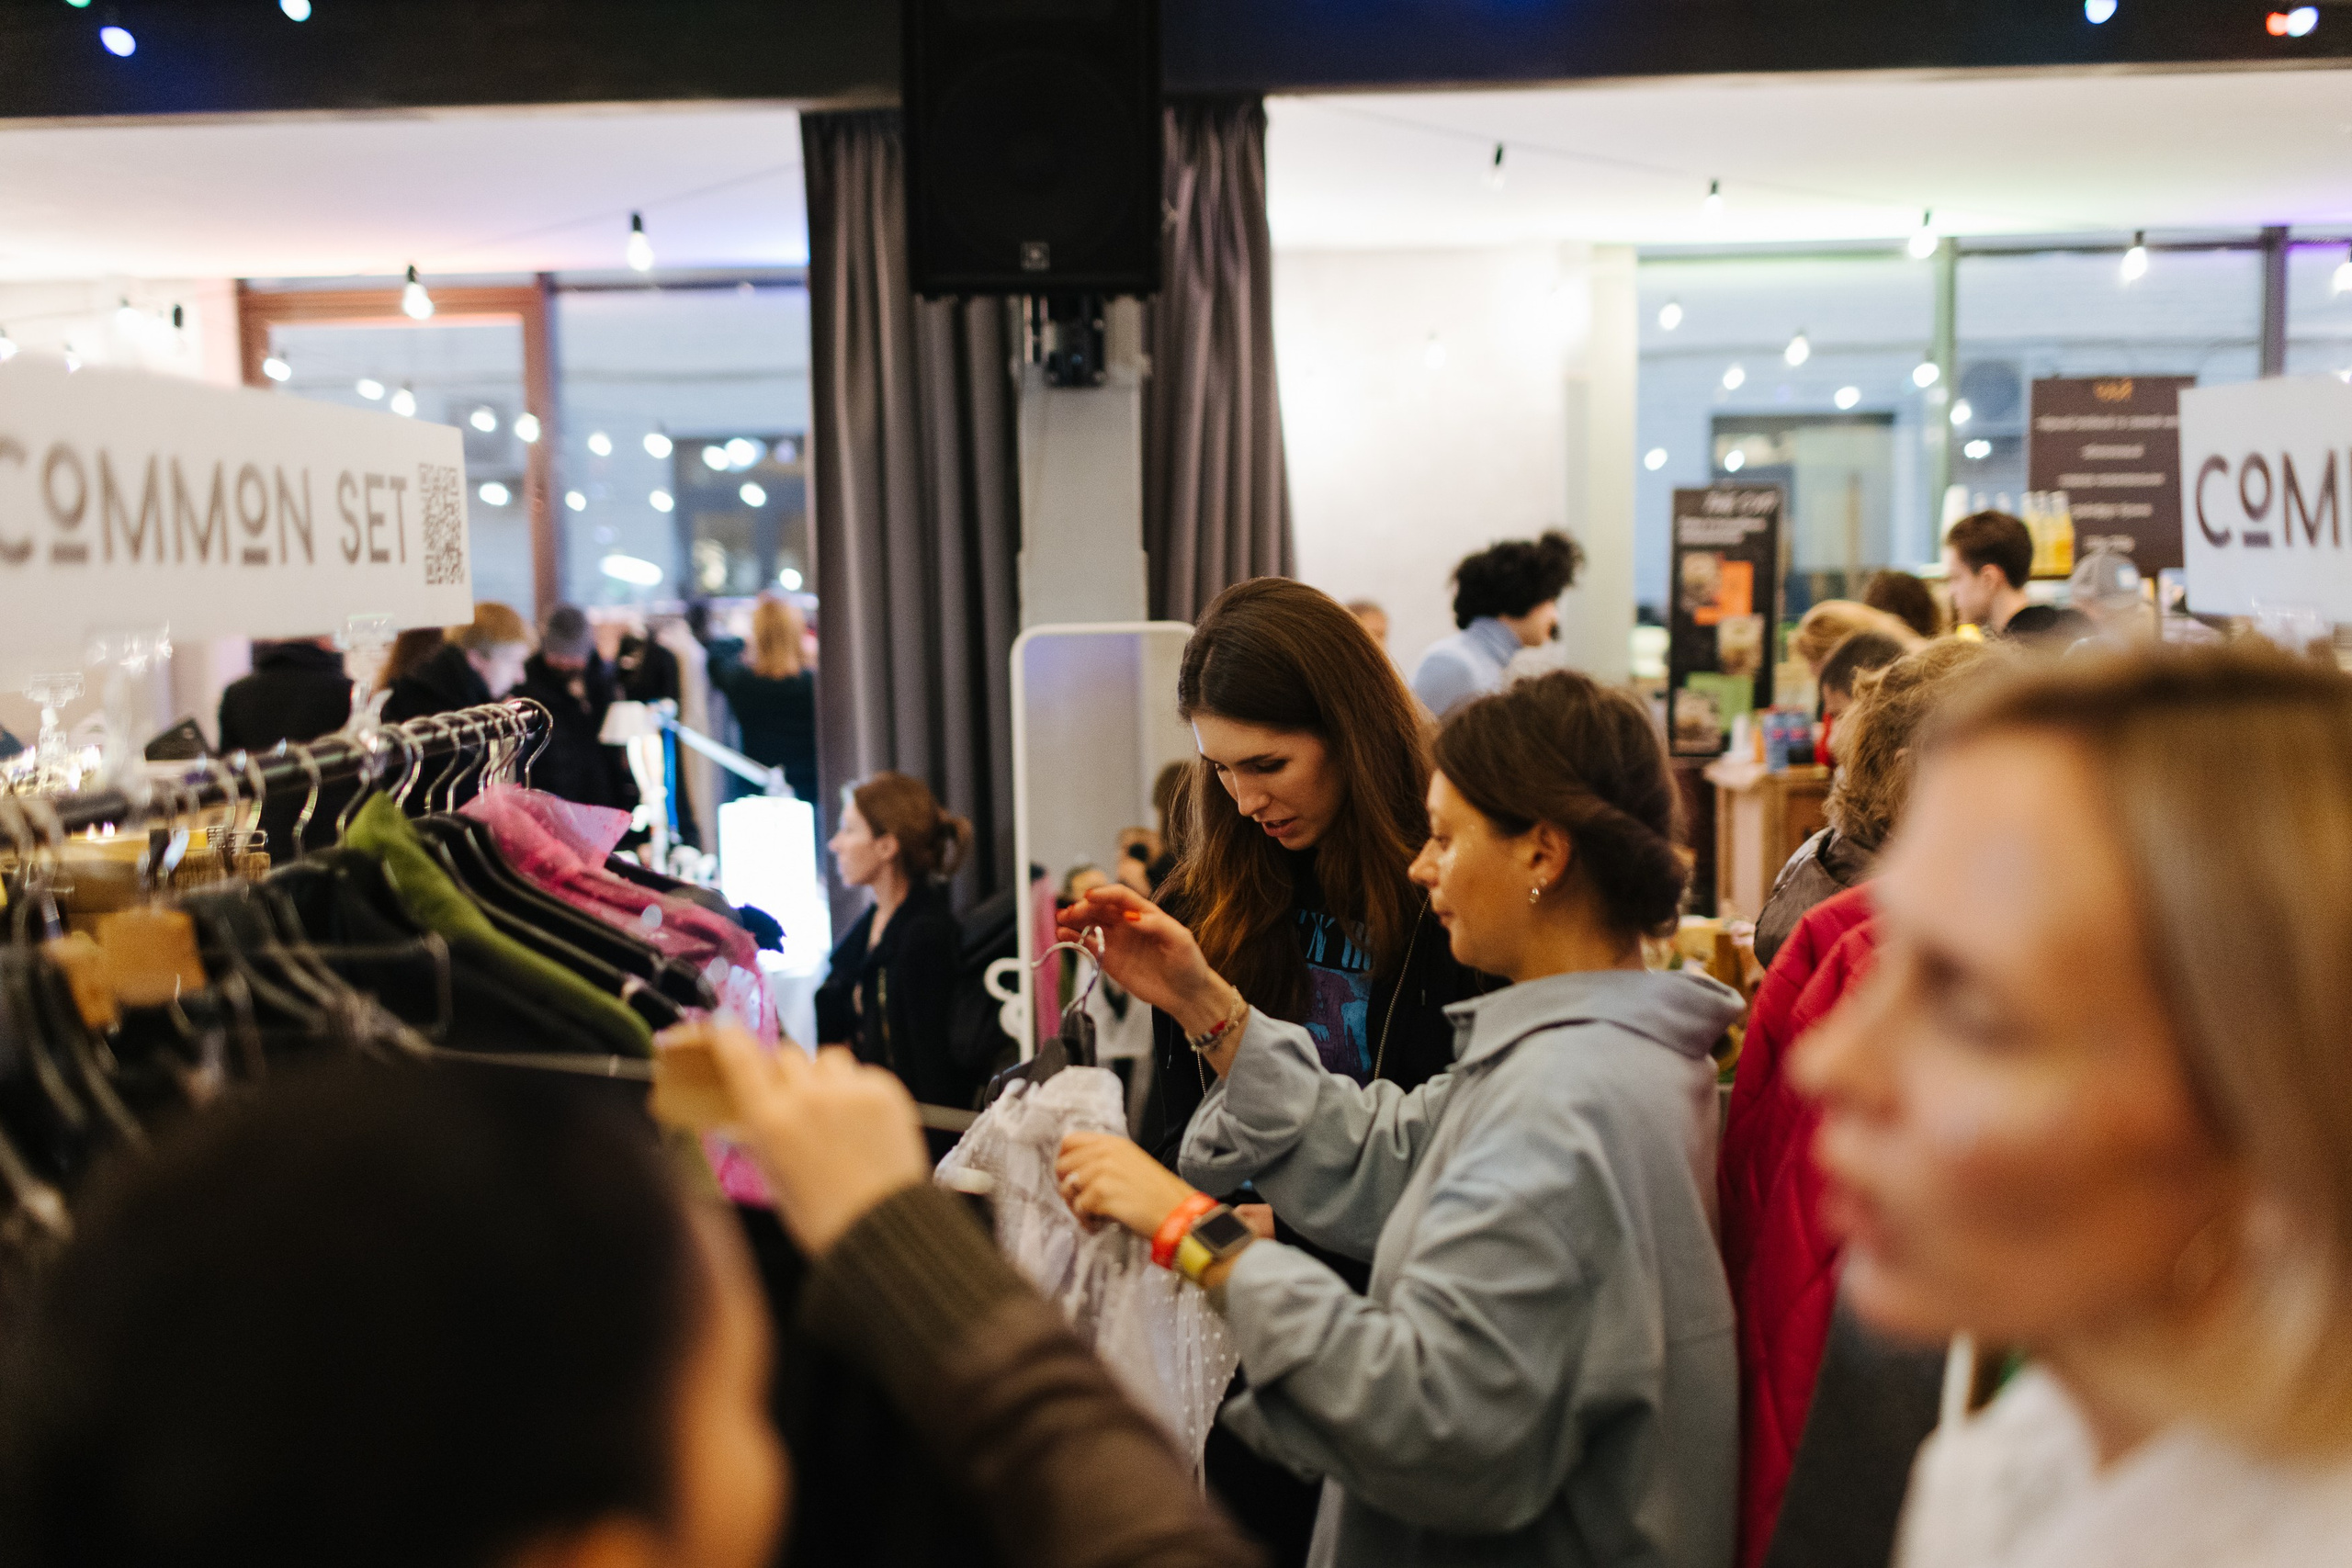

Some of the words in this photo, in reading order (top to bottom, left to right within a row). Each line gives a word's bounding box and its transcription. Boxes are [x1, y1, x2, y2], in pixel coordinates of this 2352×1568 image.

[0, 436, 314, 566] COMMON
[336, 469, 408, 565] SET
[2195, 447, 2352, 549] COM
